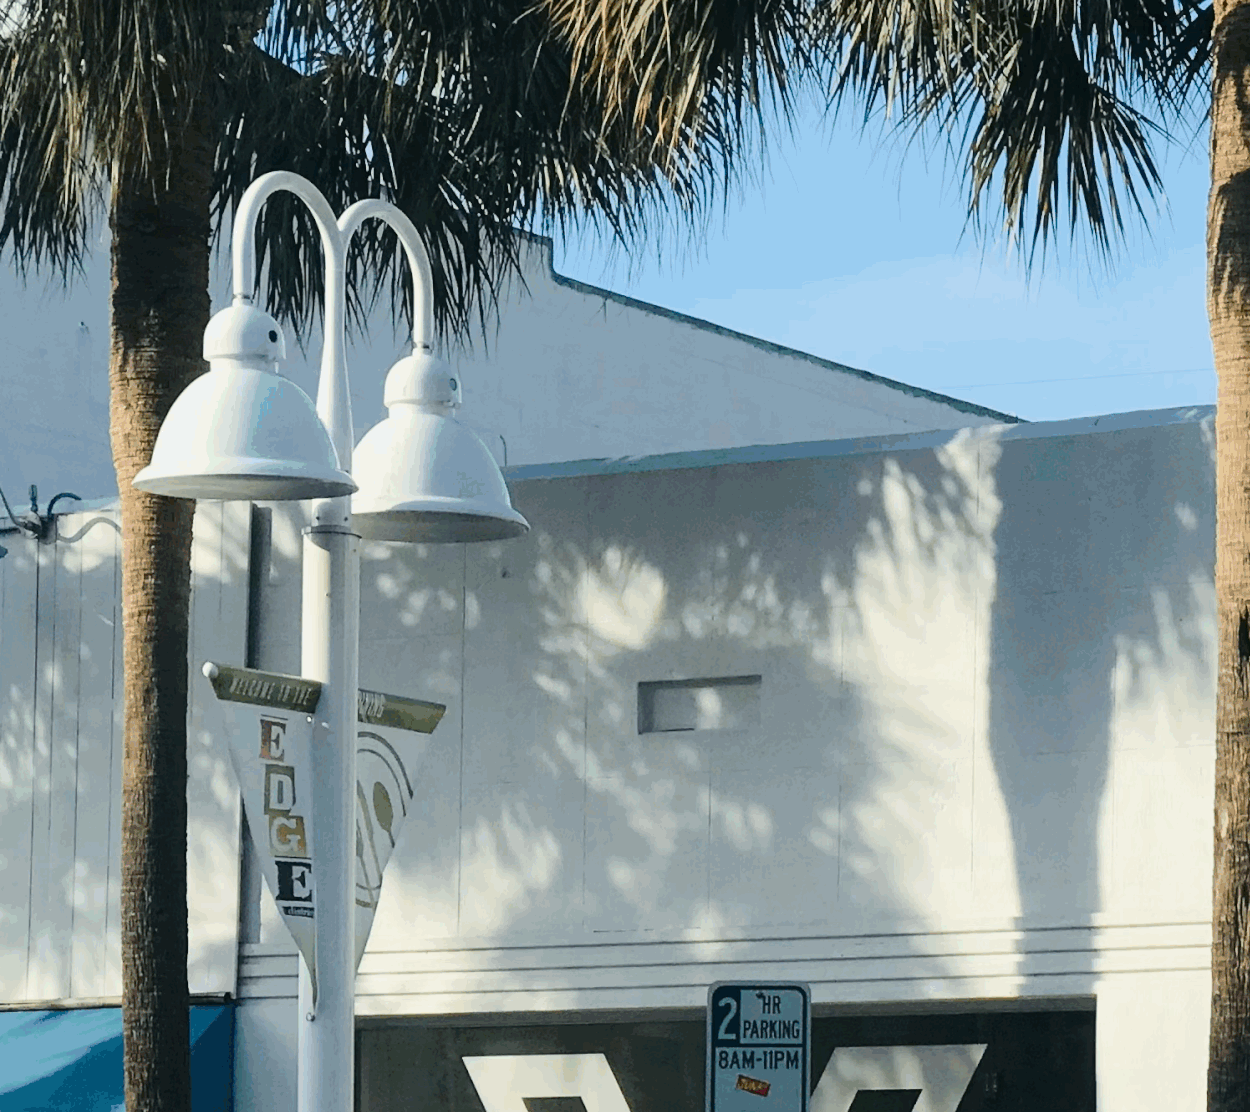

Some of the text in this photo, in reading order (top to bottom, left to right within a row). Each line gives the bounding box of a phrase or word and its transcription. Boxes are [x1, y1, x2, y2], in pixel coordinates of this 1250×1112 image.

[718, 995, 782, 1040] 2 HR
[743, 1019, 800, 1039] PARKING
[718, 1050, 800, 1070] 8AM-11PM
